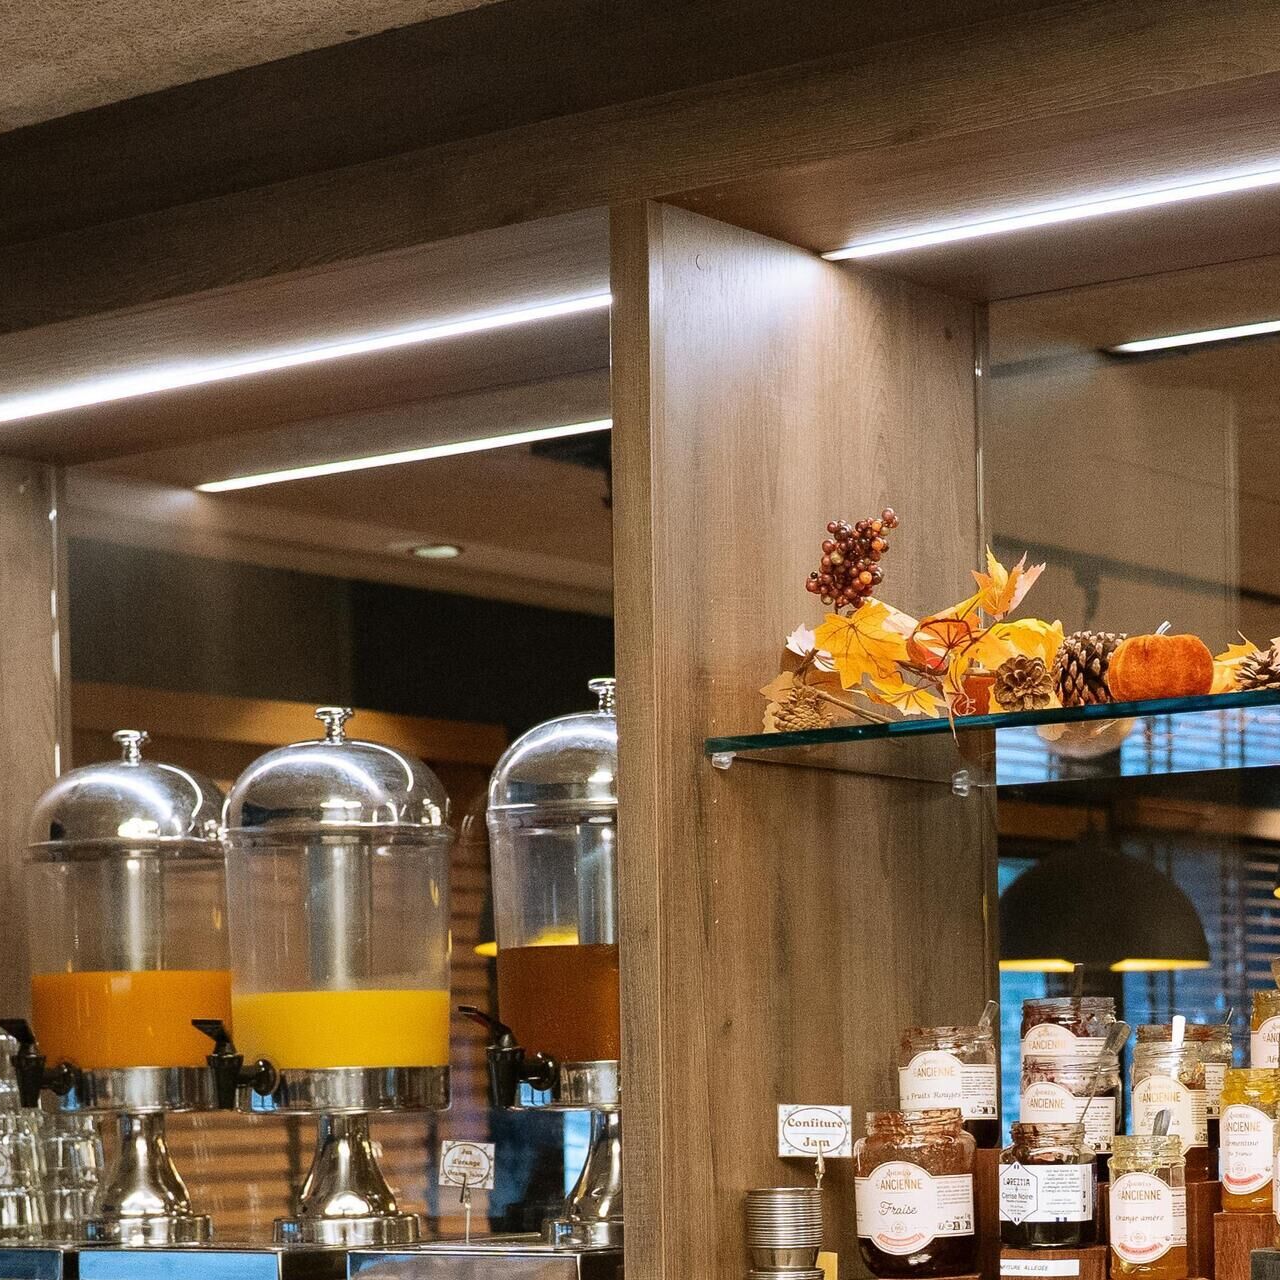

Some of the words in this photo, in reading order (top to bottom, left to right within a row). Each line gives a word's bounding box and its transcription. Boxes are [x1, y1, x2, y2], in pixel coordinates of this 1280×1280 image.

[787, 1118, 843, 1128] Confiture
[802, 1136, 831, 1147] Jam
[880, 1178, 924, 1190] ANCIENNE
[1120, 1189, 1162, 1201] ANCIENNE
[878, 1200, 919, 1216] Fraise
